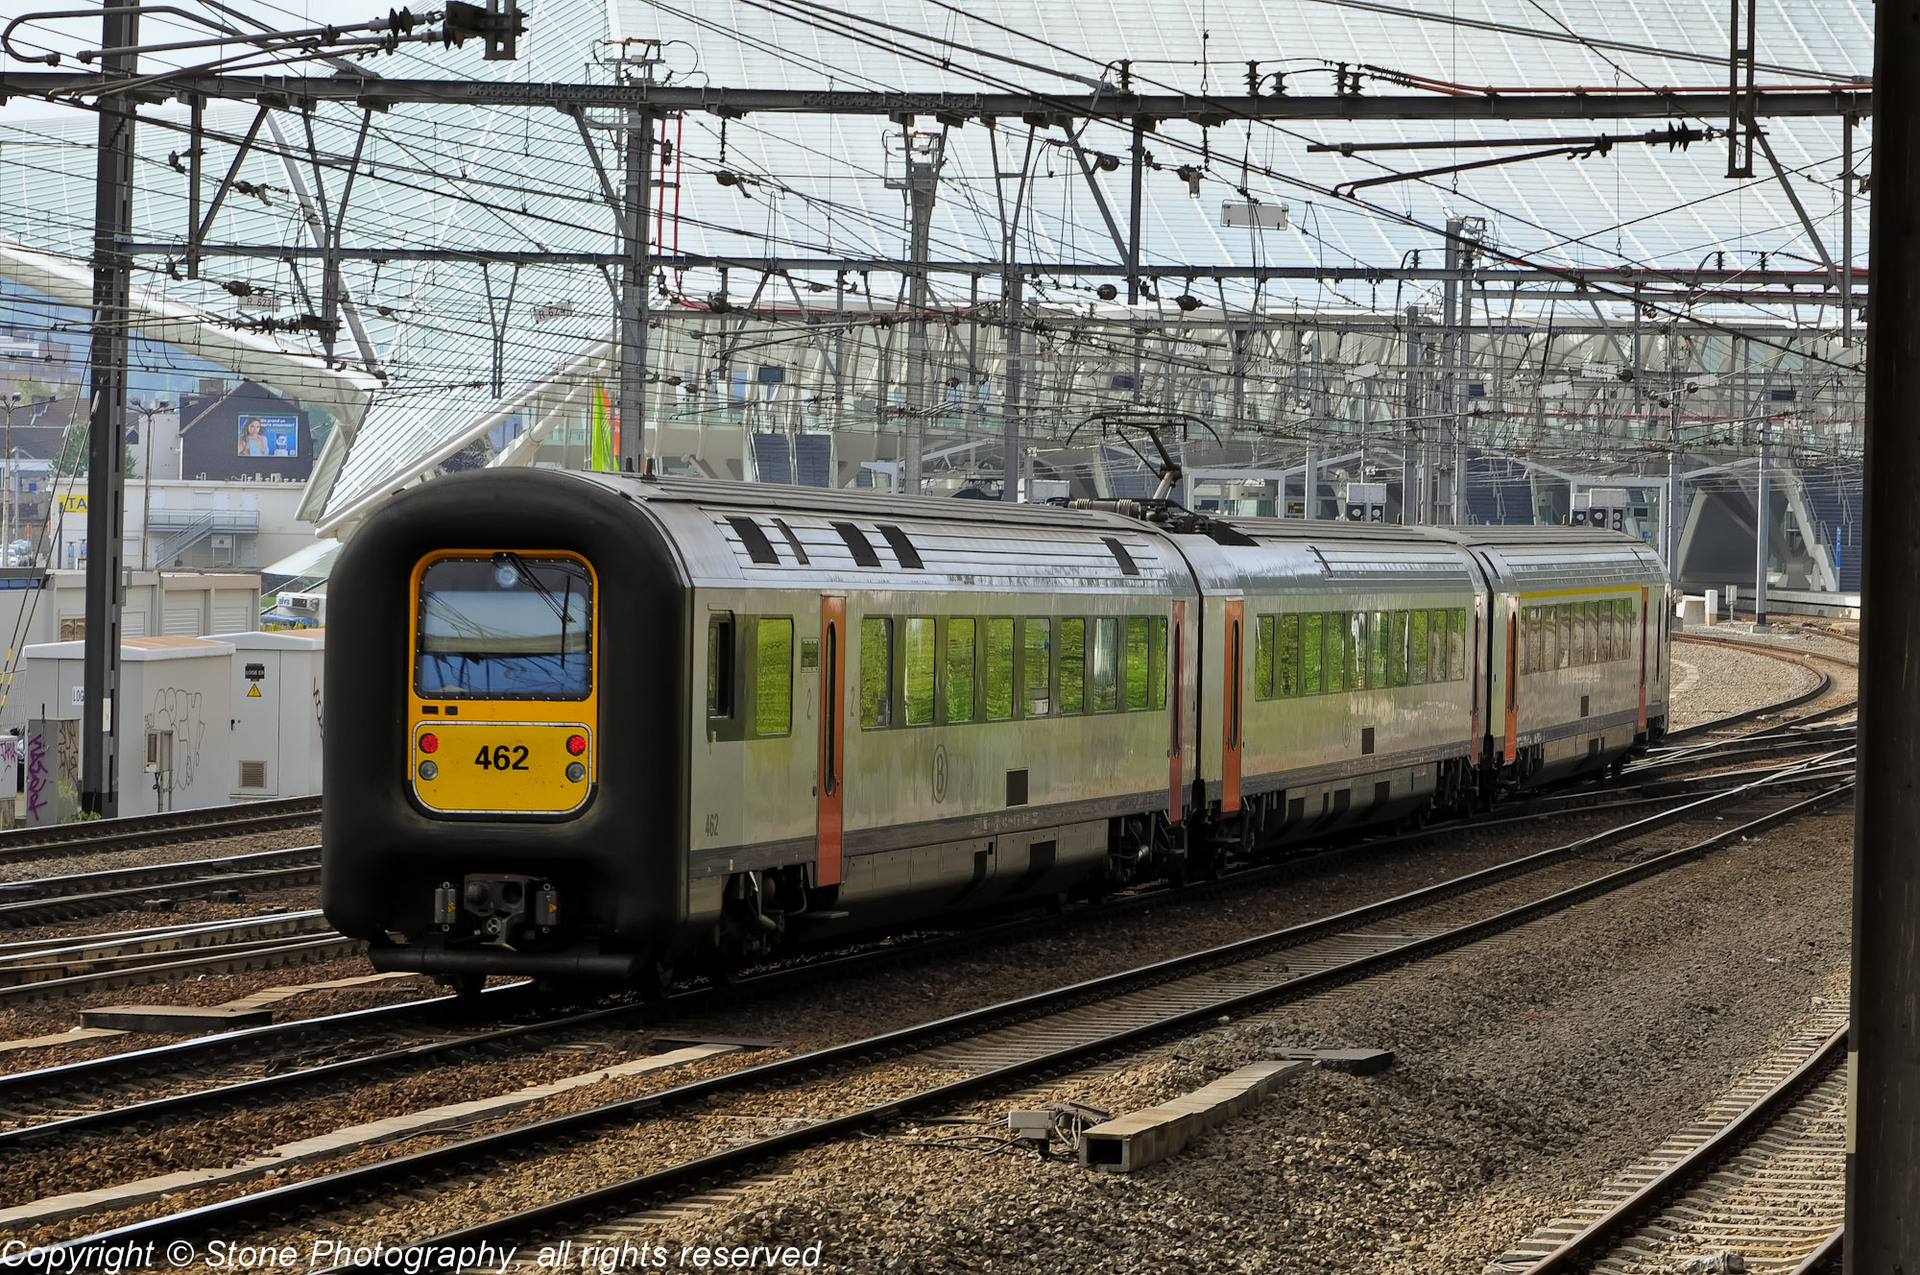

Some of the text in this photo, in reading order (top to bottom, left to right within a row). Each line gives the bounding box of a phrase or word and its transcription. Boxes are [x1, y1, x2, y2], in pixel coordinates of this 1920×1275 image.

[257, 298, 272, 308] 623
[538, 310, 546, 320] R
[1183, 343, 1197, 353] 622
[806, 687, 812, 720] 2
[475, 745, 529, 770] 462
[705, 812, 719, 837] 462
